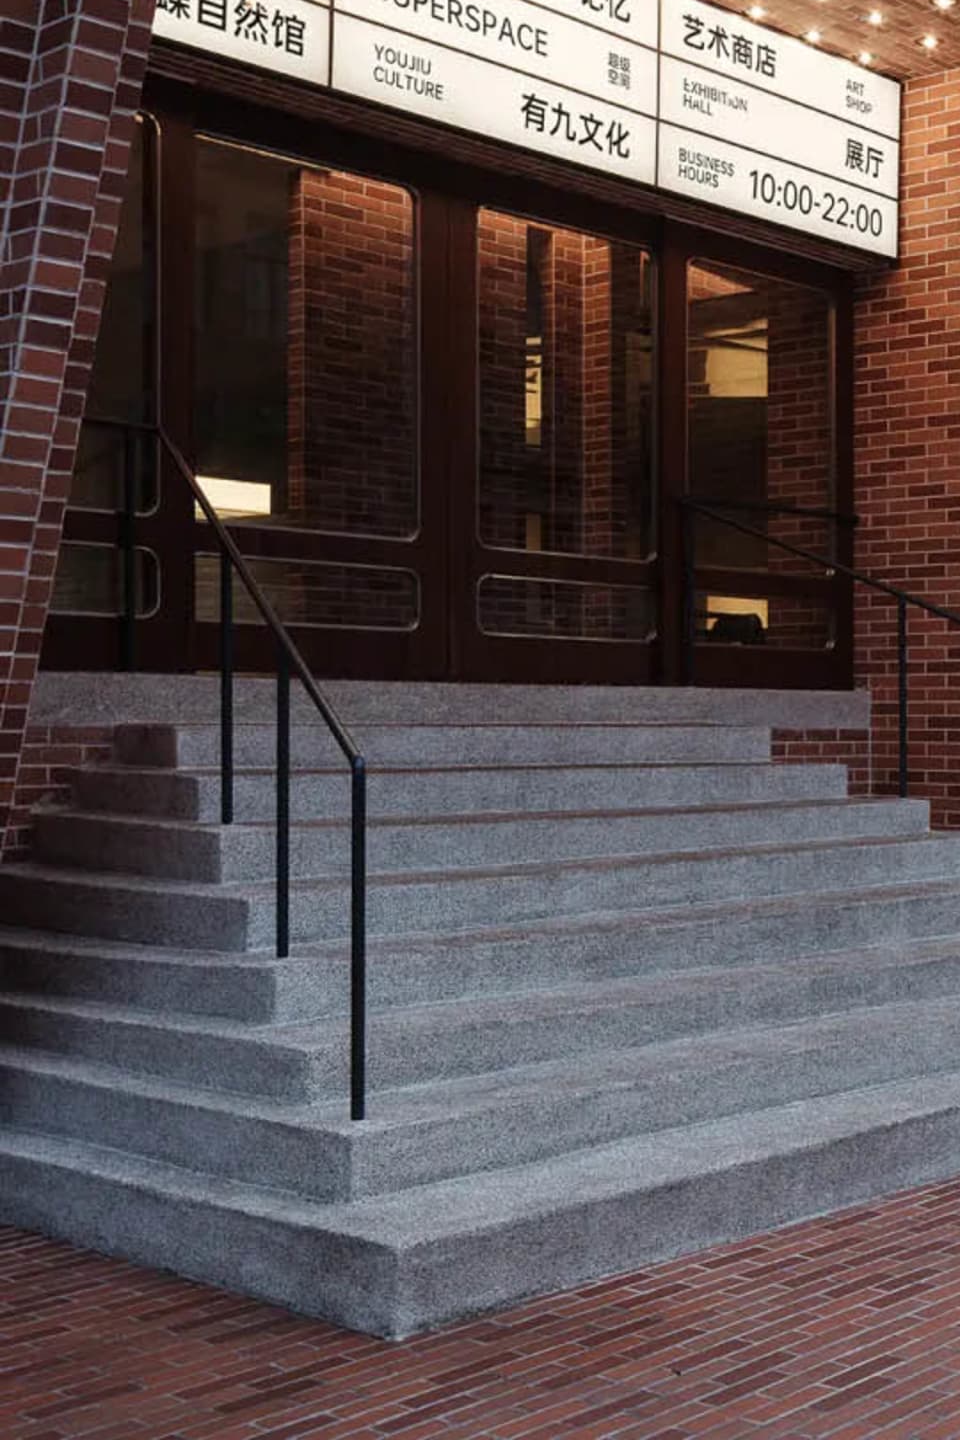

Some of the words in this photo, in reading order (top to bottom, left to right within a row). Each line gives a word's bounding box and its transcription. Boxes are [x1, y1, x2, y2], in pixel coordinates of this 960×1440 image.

[374, 43, 432, 76] YOUJIU
[682, 14, 777, 79] 艺术商店
[373, 65, 445, 101] CULTURE
[682, 77, 749, 112] EXHIBITION
[845, 78, 865, 97] ART
[682, 93, 714, 117] HALL
[521, 93, 631, 159] 有九文化
[677, 146, 736, 177] BUSINESS
[844, 137, 884, 179] 展厅
[677, 164, 720, 189] HOURS
[748, 169, 883, 238] 10:00-22:00
